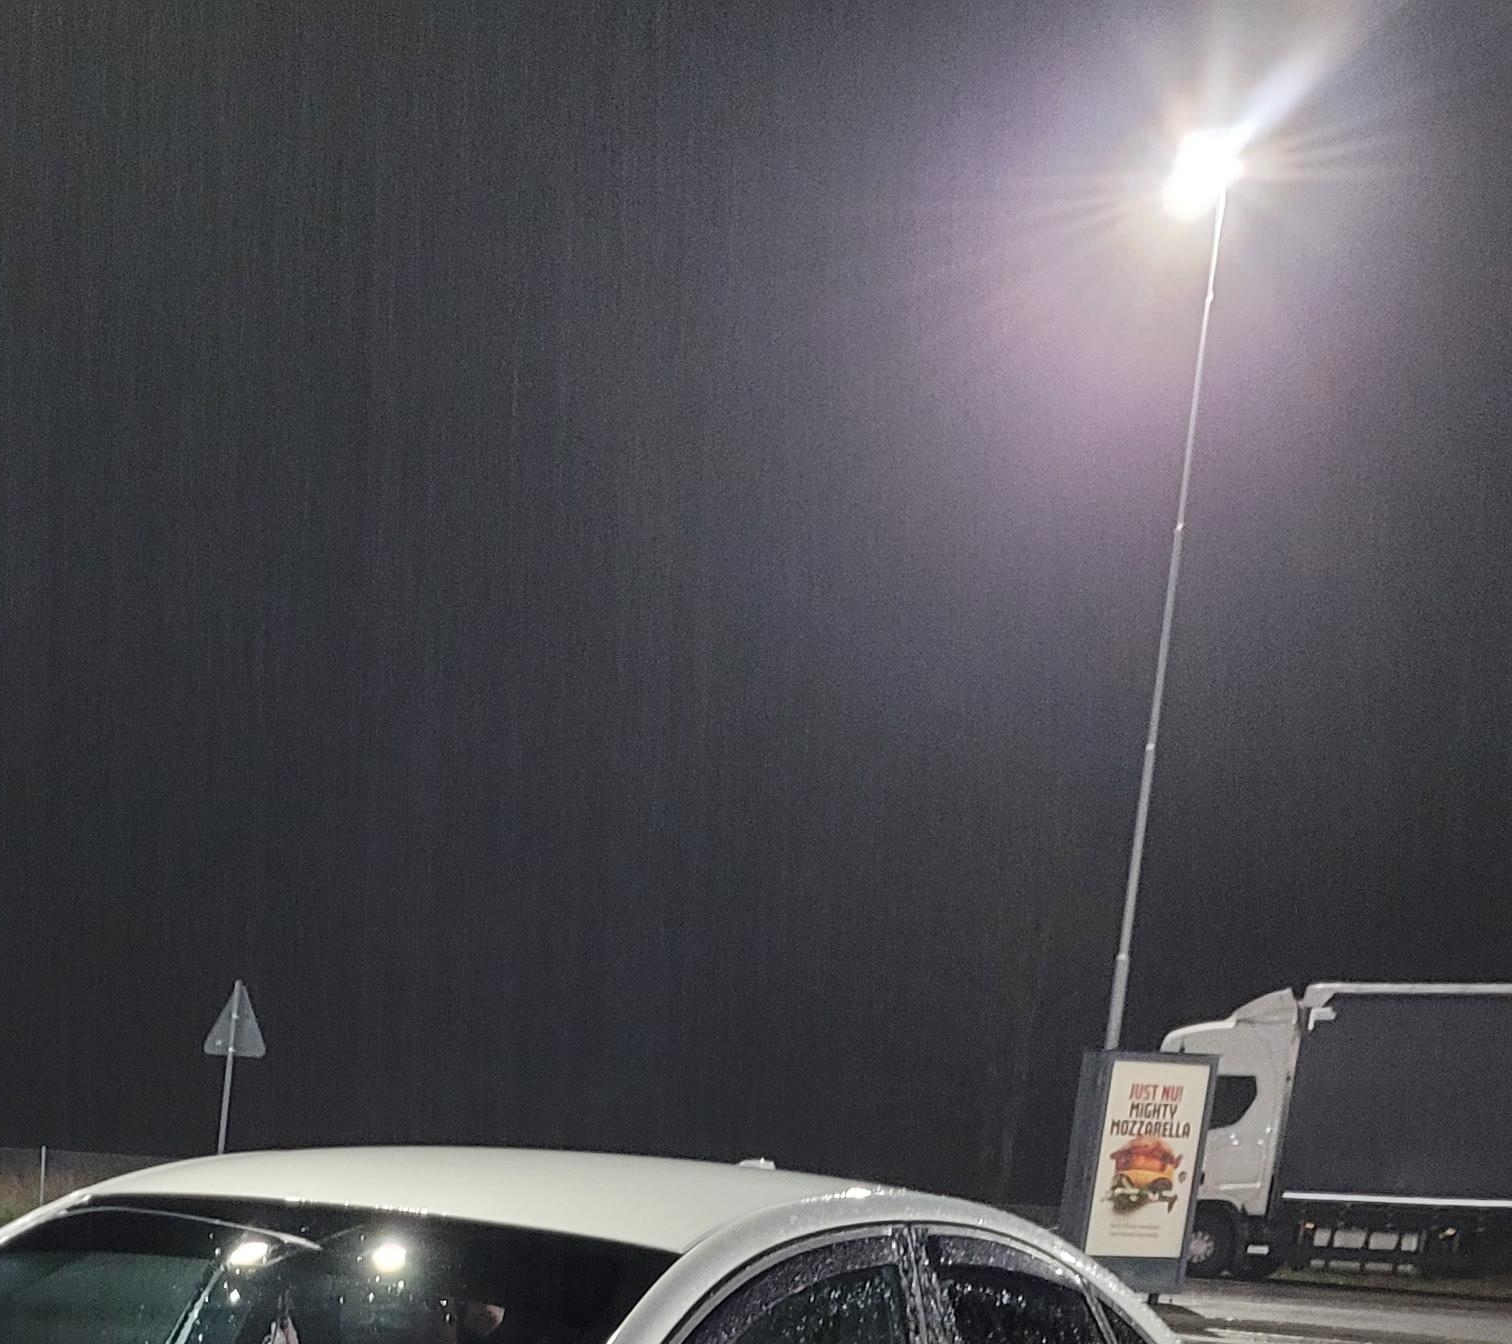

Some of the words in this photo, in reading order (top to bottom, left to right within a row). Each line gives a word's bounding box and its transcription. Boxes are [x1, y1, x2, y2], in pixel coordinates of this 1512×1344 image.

[1129, 1083, 1158, 1101] JUST
[1161, 1085, 1184, 1102] NU!
[1129, 1102, 1178, 1119] MIGHTY
[1110, 1119, 1191, 1139] MOZZARELLA
